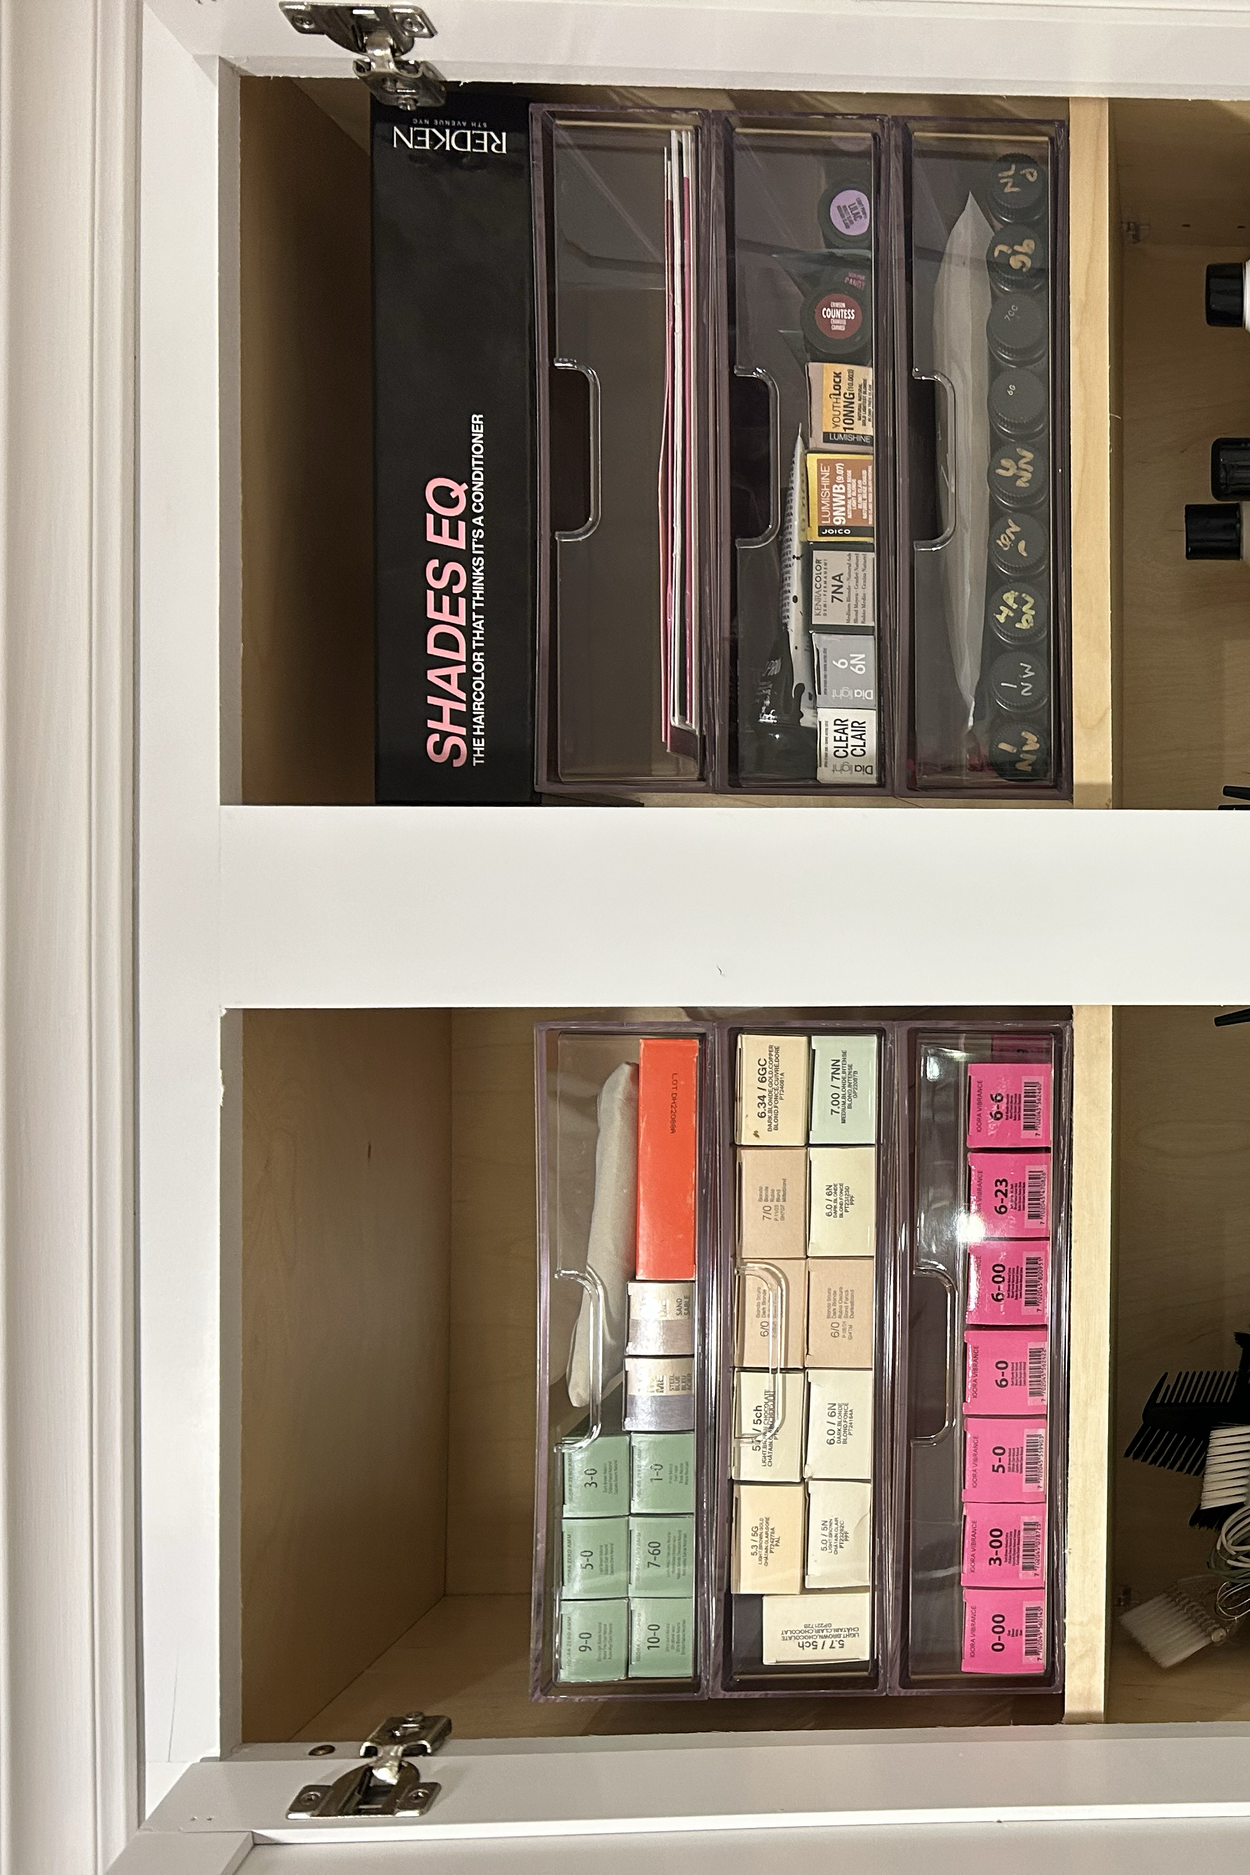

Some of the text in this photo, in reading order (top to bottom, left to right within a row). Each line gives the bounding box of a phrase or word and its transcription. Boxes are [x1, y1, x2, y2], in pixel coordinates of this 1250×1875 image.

[470, 120, 487, 128] 5TH
[393, 125, 508, 154] REDKEN
[848, 202, 864, 220] LILAC
[822, 308, 855, 319] COUNTESS
[843, 392, 855, 432] 10NNG
[830, 436, 872, 444] LUMISHINE
[472, 414, 484, 513] CONDITIONER
[820, 466, 831, 524] LUMISHINE
[832, 462, 846, 525] 9NWB (9.07)
[472, 516, 484, 526] A
[472, 556, 484, 608] THINKS
[814, 558, 822, 616] KENRACOLOR
[831, 572, 844, 603] 7NA
[425, 476, 469, 767] SHADES EQ
[472, 612, 485, 649] THAT
[832, 659, 848, 669] 6
[850, 653, 866, 674] 6N
[1020, 662, 1036, 696] NW
[472, 650, 485, 735] HAIRCOLOR
[834, 718, 849, 758] CLEAR
[851, 720, 866, 757] CLAIR
[1016, 730, 1040, 772] NW
[472, 738, 485, 766] THE
[758, 1058, 767, 1083] 6GC
[831, 1059, 841, 1081] 7NN
[758, 1091, 767, 1118] 6.34
[830, 1093, 840, 1116] 7.00
[990, 1092, 1004, 1121] 6-6
[825, 1184, 833, 1196] 6N
[994, 1178, 1008, 1214] 6-23
[763, 1205, 772, 1221] 7/0
[825, 1204, 833, 1217] 6.0
[991, 1264, 1005, 1302] 6-00
[760, 1321, 770, 1337] 6/0
[830, 1322, 840, 1338] 6/0
[994, 1360, 1008, 1388] 6-0
[827, 1402, 836, 1418] 6N
[826, 1429, 836, 1445] 6.0
[650, 1463, 664, 1482] 1-0
[992, 1446, 1006, 1474] 5-0
[584, 1468, 598, 1488] 3-0
[751, 1526, 759, 1537] 5G
[821, 1520, 828, 1531] 5N
[580, 1550, 594, 1570] 5-0
[647, 1542, 661, 1568] 7-60
[988, 1528, 1002, 1567] 3-00
[578, 1632, 592, 1652] 9-0
[647, 1624, 661, 1650] 10-0
[798, 1640, 818, 1650] 5ch
[829, 1639, 845, 1649] 5.7
[991, 1614, 1005, 1652] 0-00
